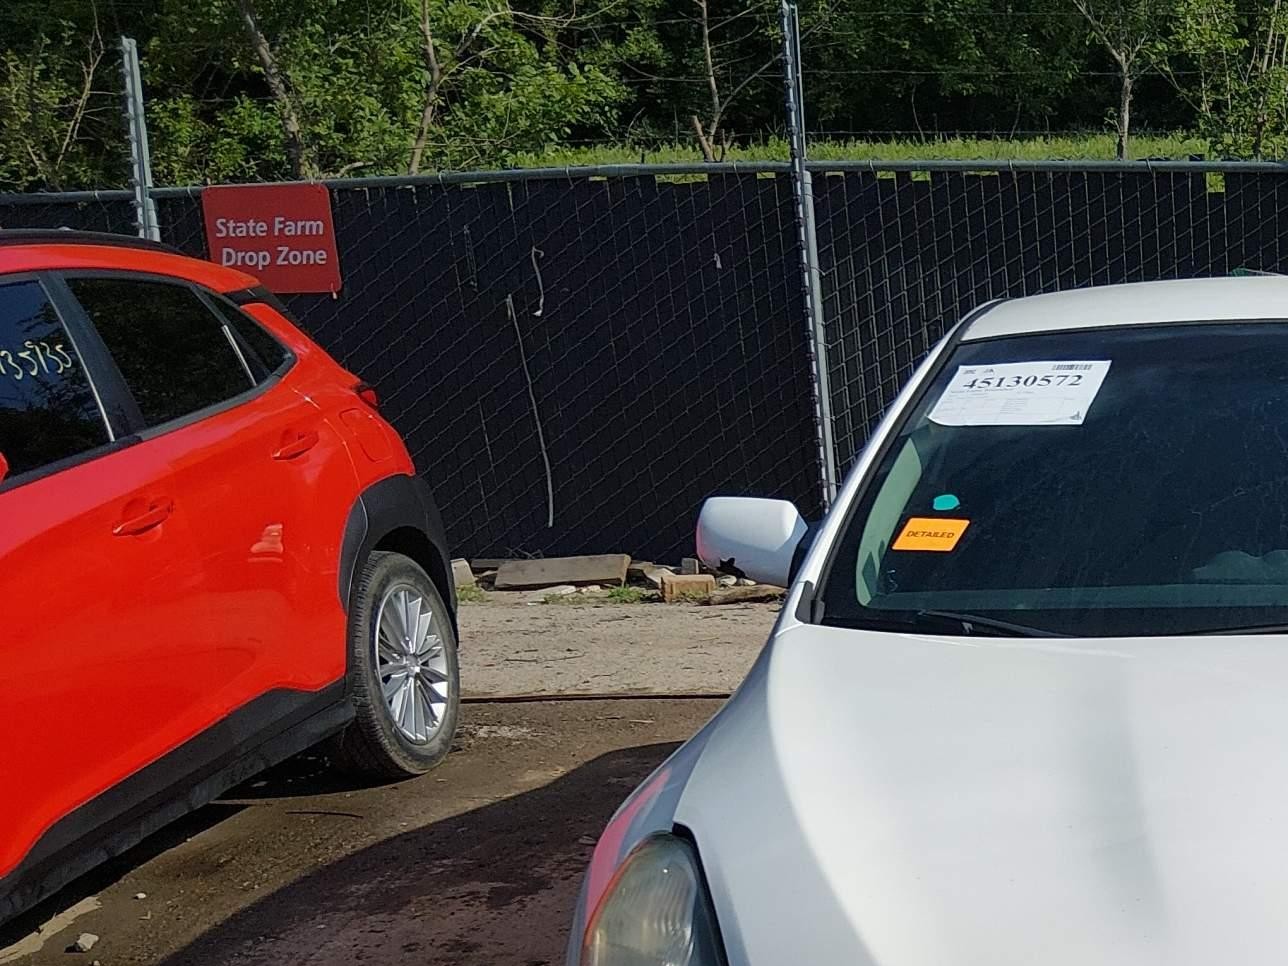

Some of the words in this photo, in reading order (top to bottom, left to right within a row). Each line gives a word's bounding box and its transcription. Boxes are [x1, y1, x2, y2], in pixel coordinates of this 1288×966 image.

[215, 218, 268, 238] State
[273, 216, 324, 236] Farm
[222, 246, 271, 271] Drop
[276, 246, 328, 266] Zone
[963, 374, 1083, 390] 45130572
[906, 530, 955, 539] DETAILED
